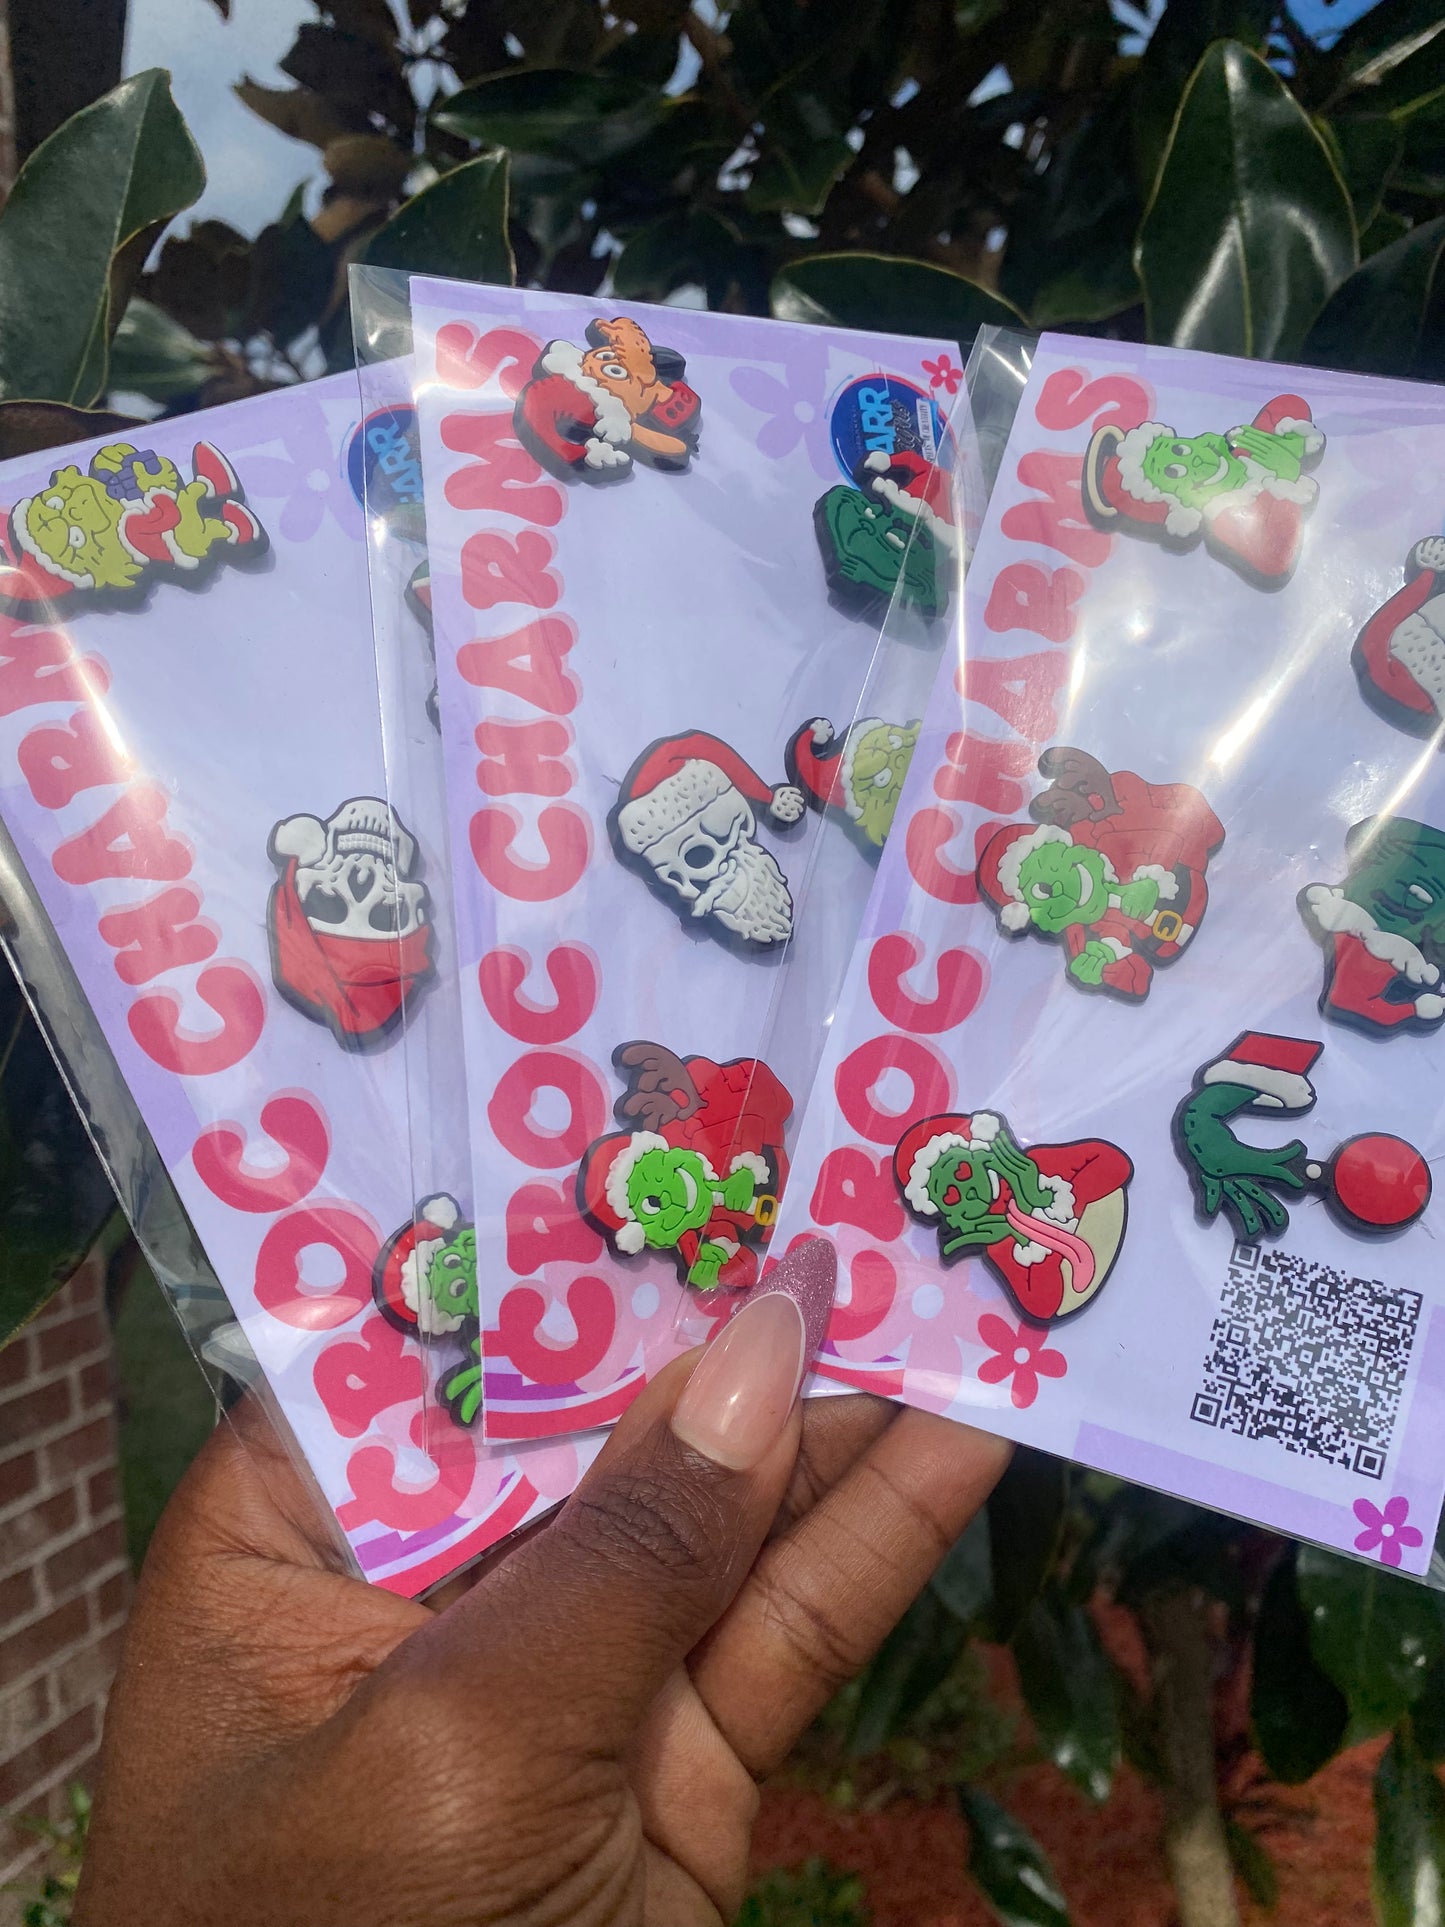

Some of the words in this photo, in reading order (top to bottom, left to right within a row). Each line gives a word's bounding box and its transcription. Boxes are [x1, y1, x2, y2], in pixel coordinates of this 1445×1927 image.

[367, 427, 424, 504] ARR
[436, 320, 596, 904] CHARMS
[0, 508, 265, 1078] CHARM
[790, 932, 989, 1342] CROC
[907, 367, 1154, 905] CHARMS
[193, 1086, 478, 1532] CROC
[480, 940, 617, 1386] CROC
